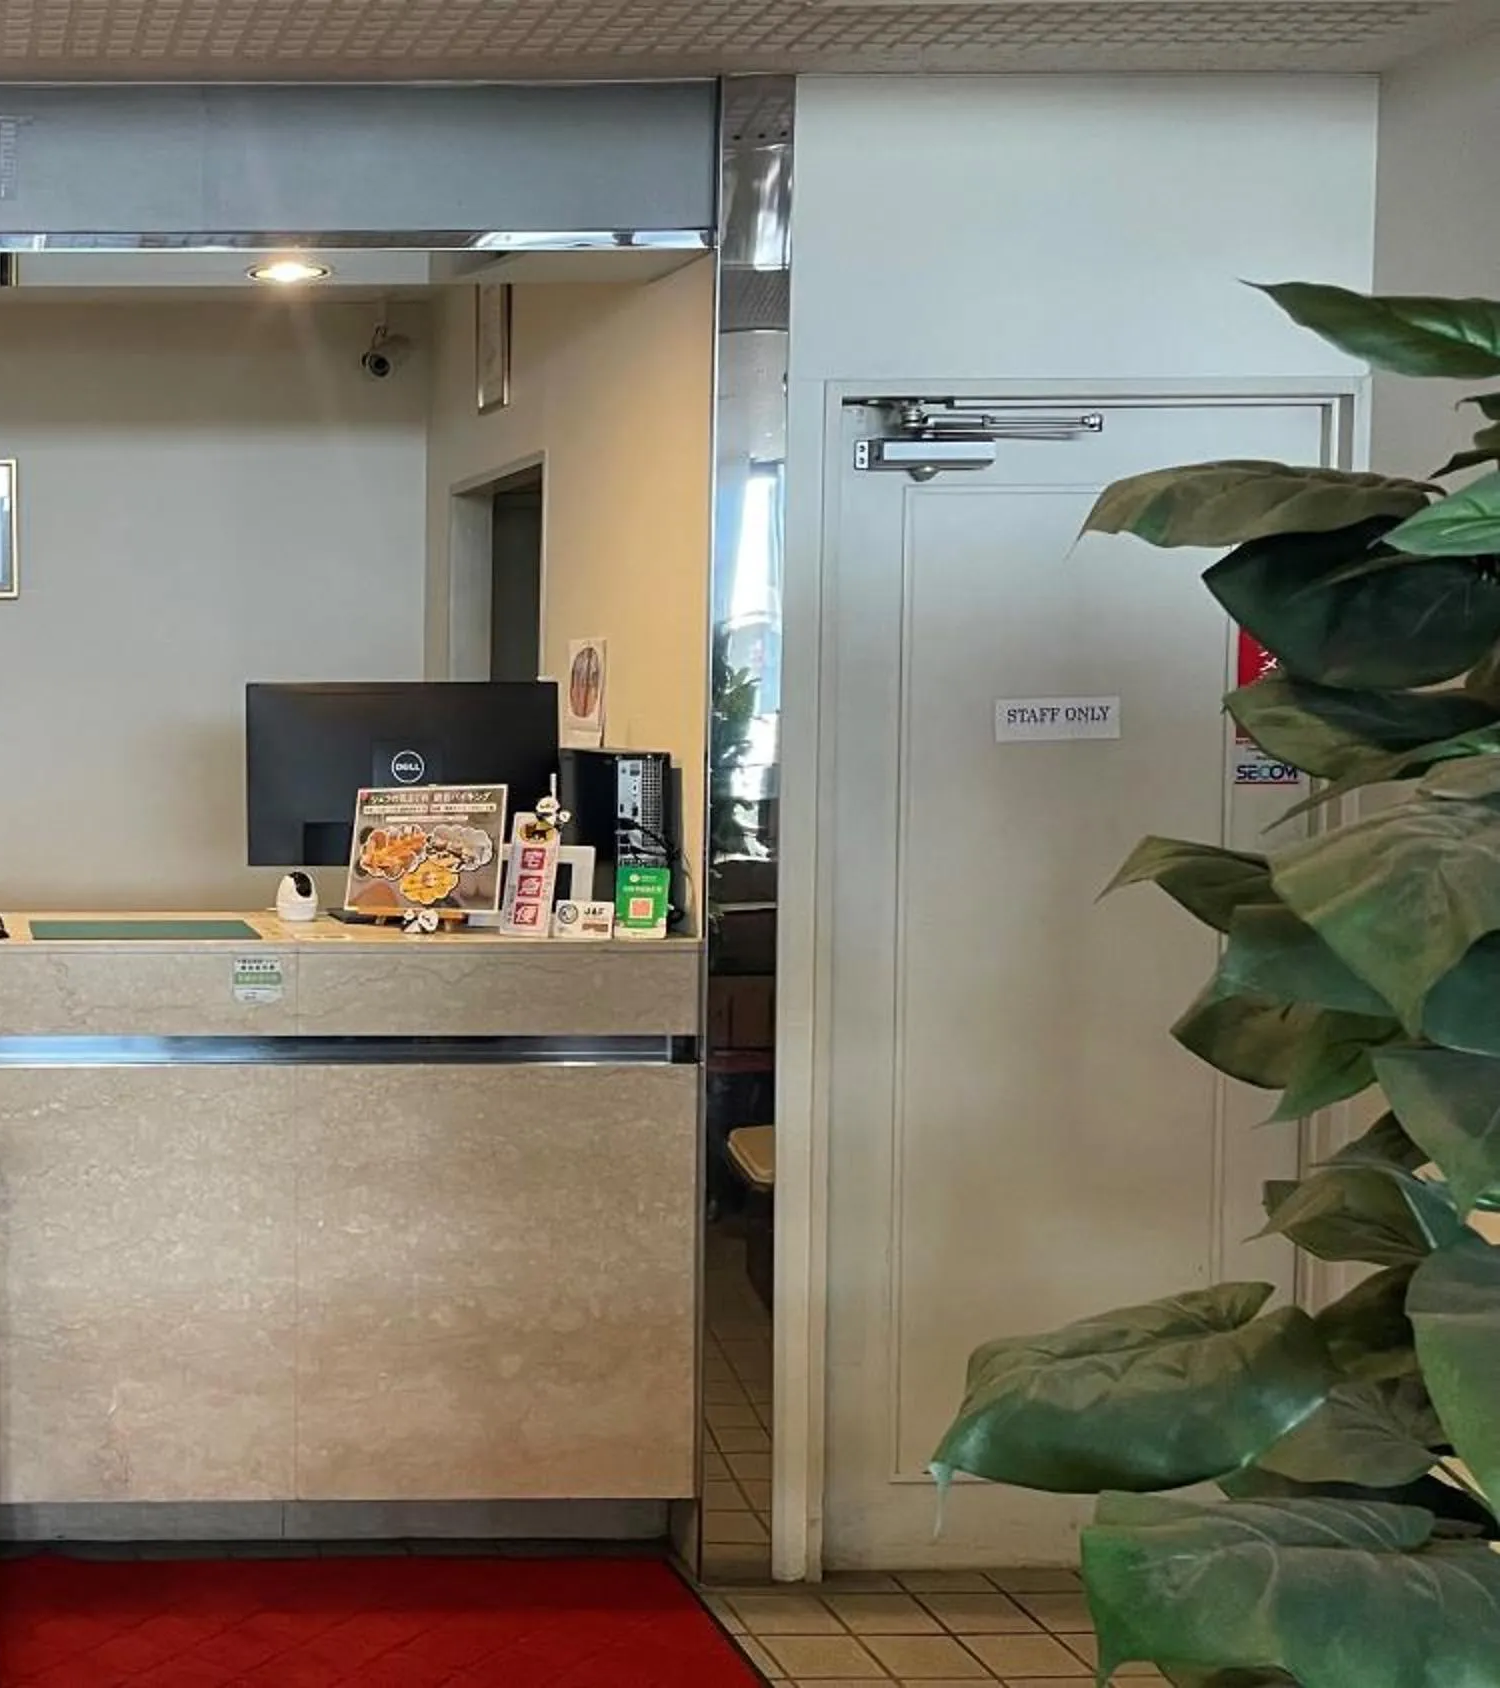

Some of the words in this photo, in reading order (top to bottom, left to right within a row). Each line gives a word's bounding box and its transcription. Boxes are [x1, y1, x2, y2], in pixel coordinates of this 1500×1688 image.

[1007, 707, 1060, 724] STAFF
[1065, 706, 1110, 721] ONLY
[395, 763, 420, 771] DELL
[1237, 765, 1297, 780] SECOM
[514, 847, 546, 925] 宅急便
